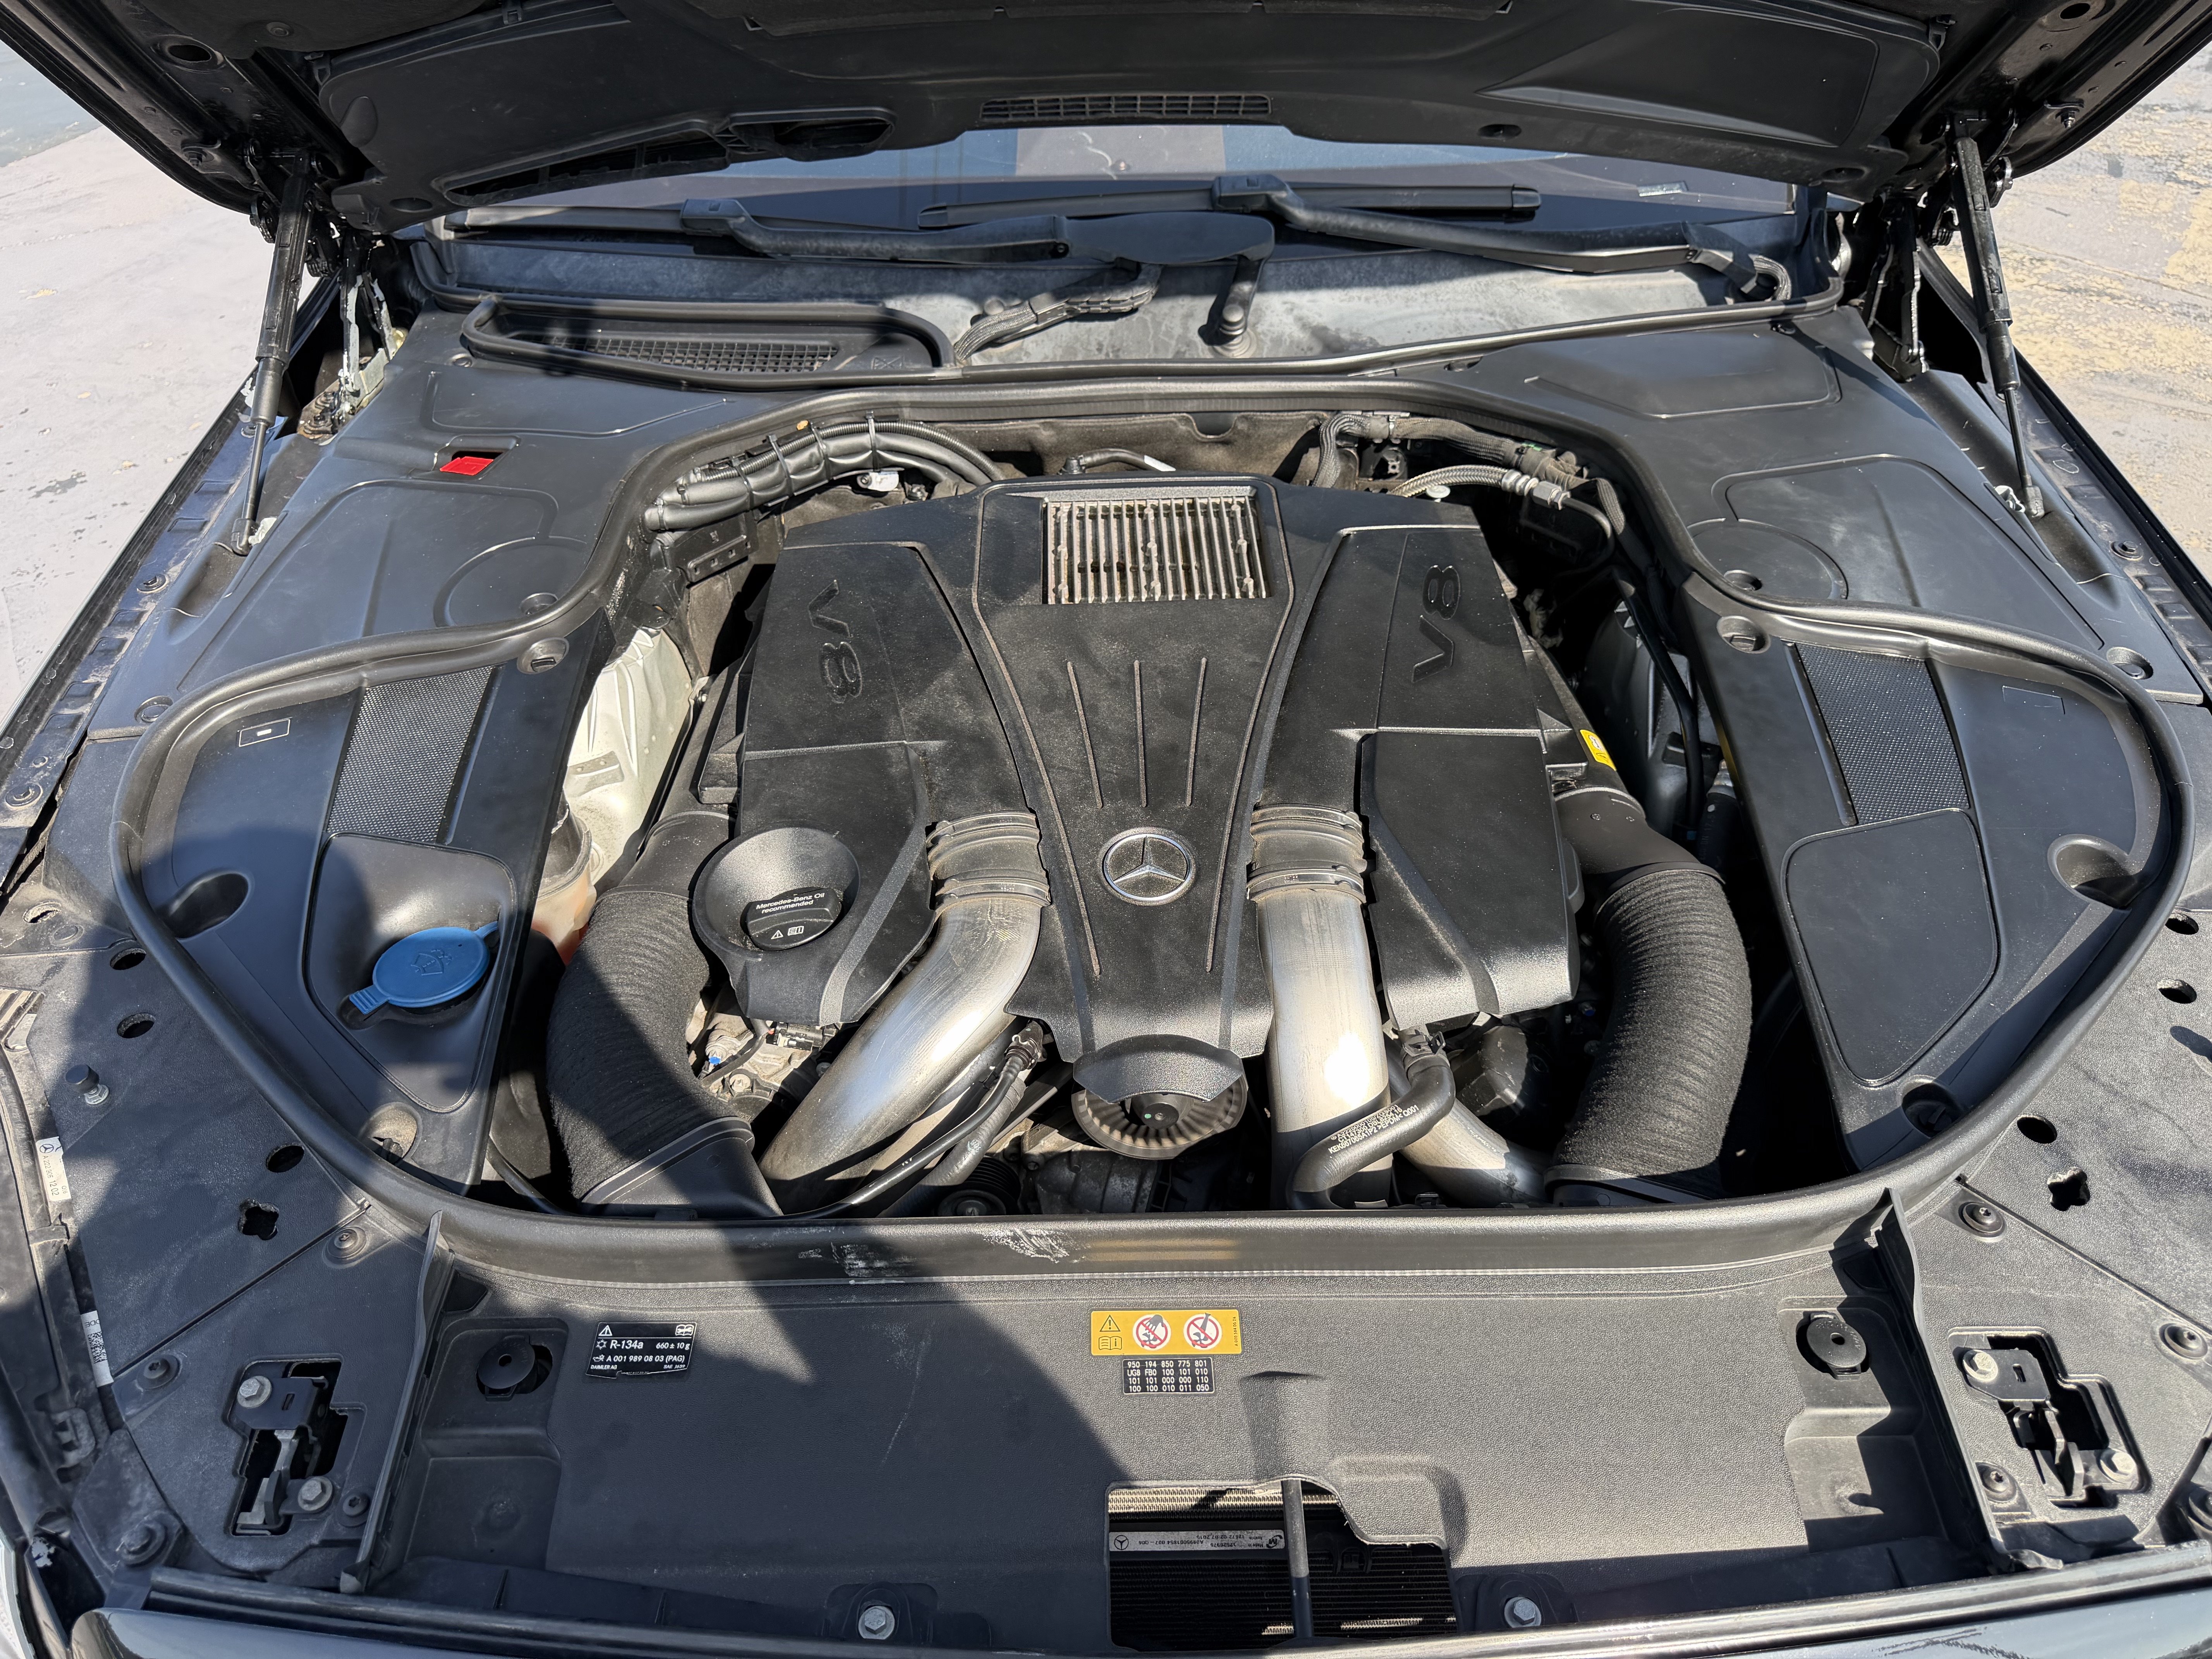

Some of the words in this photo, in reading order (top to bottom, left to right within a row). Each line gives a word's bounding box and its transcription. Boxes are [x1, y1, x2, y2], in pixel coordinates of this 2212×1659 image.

[1412, 565, 1460, 683] V8
[808, 579, 863, 704] V8
[756, 895, 813, 910] Mercedes-Benz
[761, 900, 814, 914] recommended
[1403, 1104, 1419, 1117] Q001
[610, 1340, 644, 1349] R-134a
